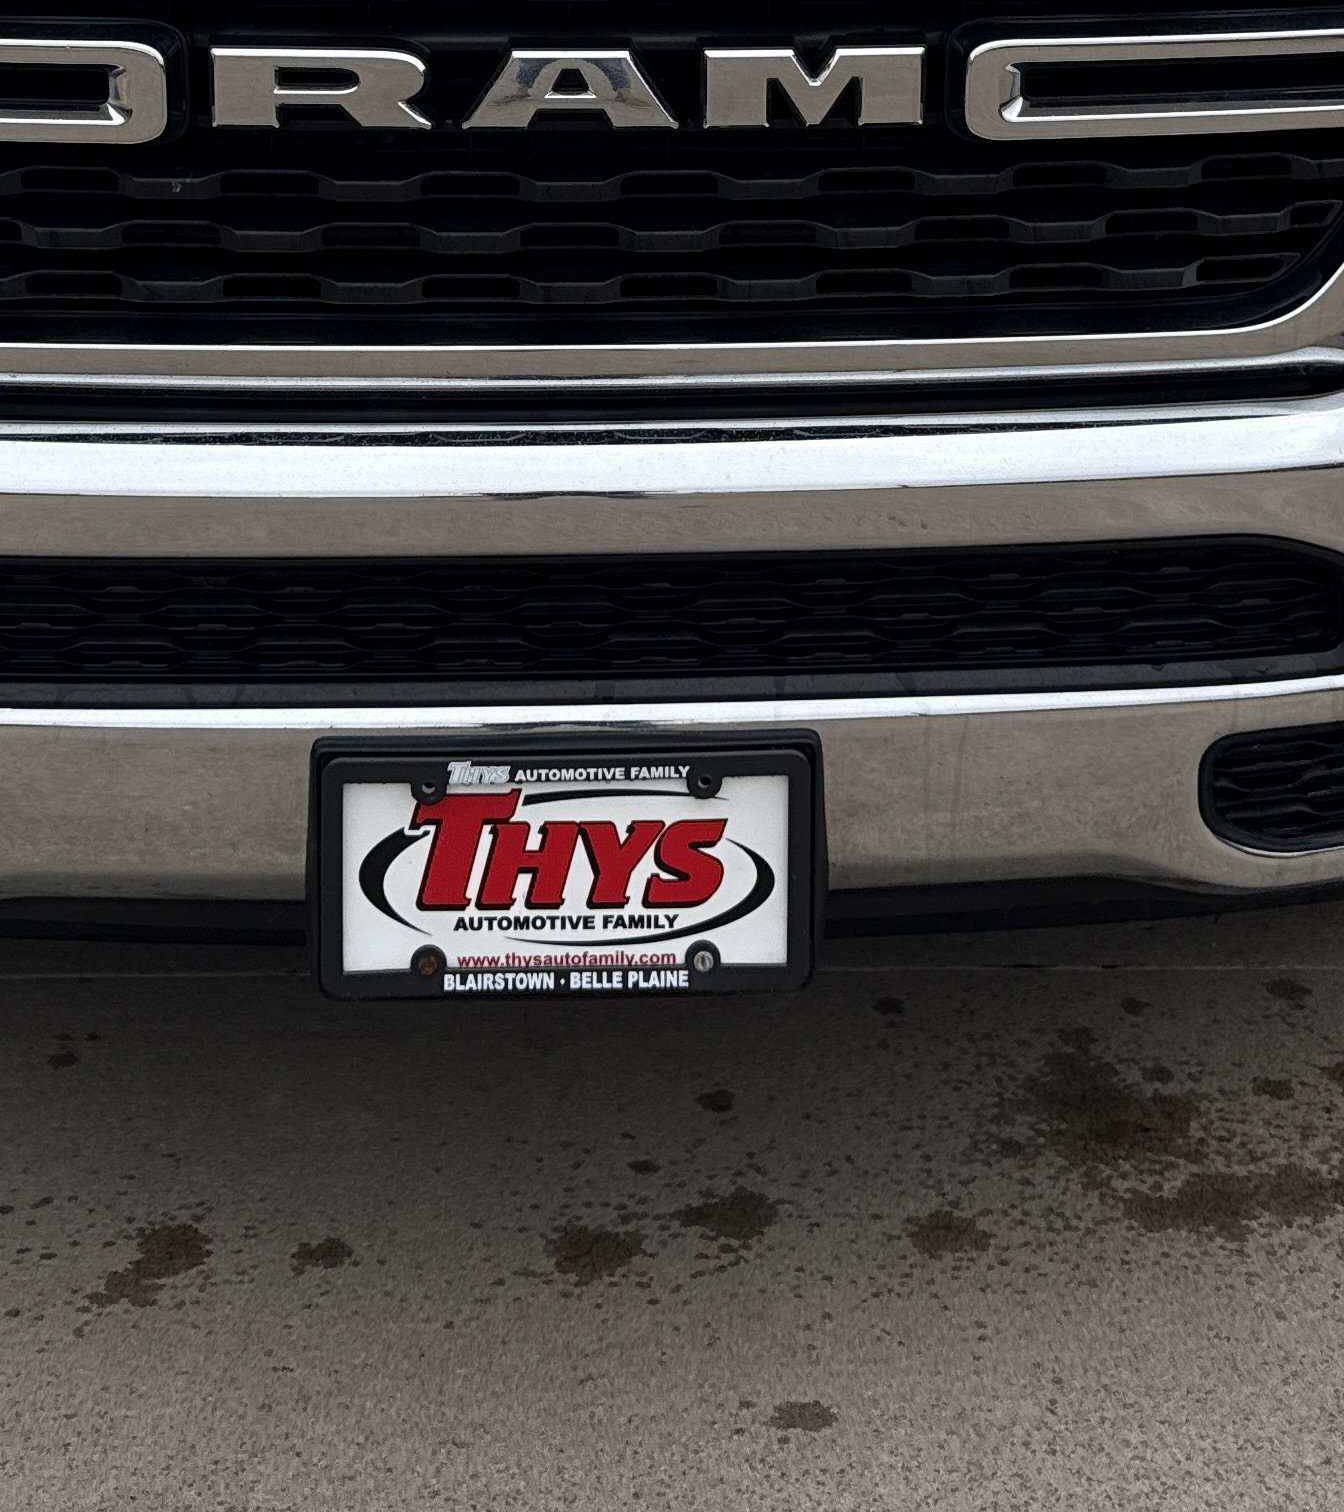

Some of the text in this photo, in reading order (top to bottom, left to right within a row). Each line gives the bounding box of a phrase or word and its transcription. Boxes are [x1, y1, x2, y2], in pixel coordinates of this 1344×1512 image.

[210, 45, 926, 130] RAM
[447, 761, 690, 784] THYS AUTOMOTIVE FAMILY
[408, 788, 728, 911] THYS
[453, 914, 679, 931] AUTOMOTIVE FAMILY
[457, 950, 676, 967] www.thysautofamily.com
[443, 969, 689, 991] BLAIRSTOWN BELLE PLAINE
